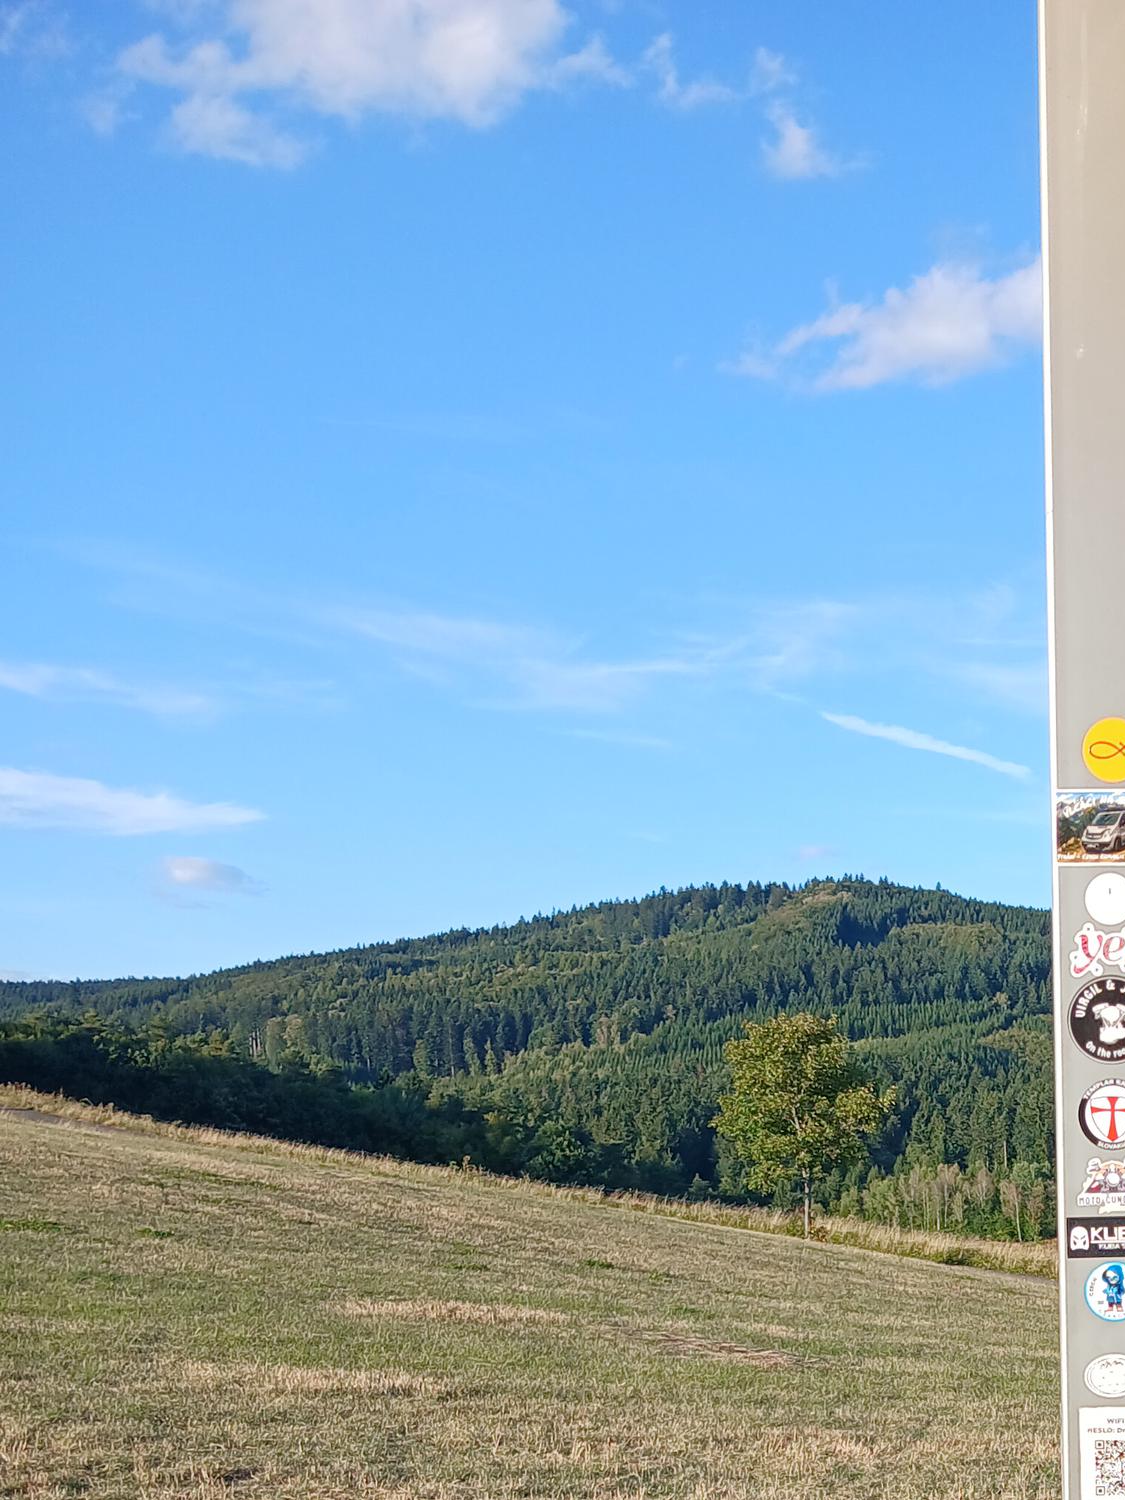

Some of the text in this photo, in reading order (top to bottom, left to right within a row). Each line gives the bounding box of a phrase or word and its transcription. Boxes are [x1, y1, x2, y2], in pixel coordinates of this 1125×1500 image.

[1075, 983, 1102, 1018] VIRGIL
[1106, 979, 1116, 990] &
[1097, 1046, 1111, 1058] the
[1083, 1079, 1114, 1099] TEMPLAR
[1079, 1196, 1101, 1205] MOTO
